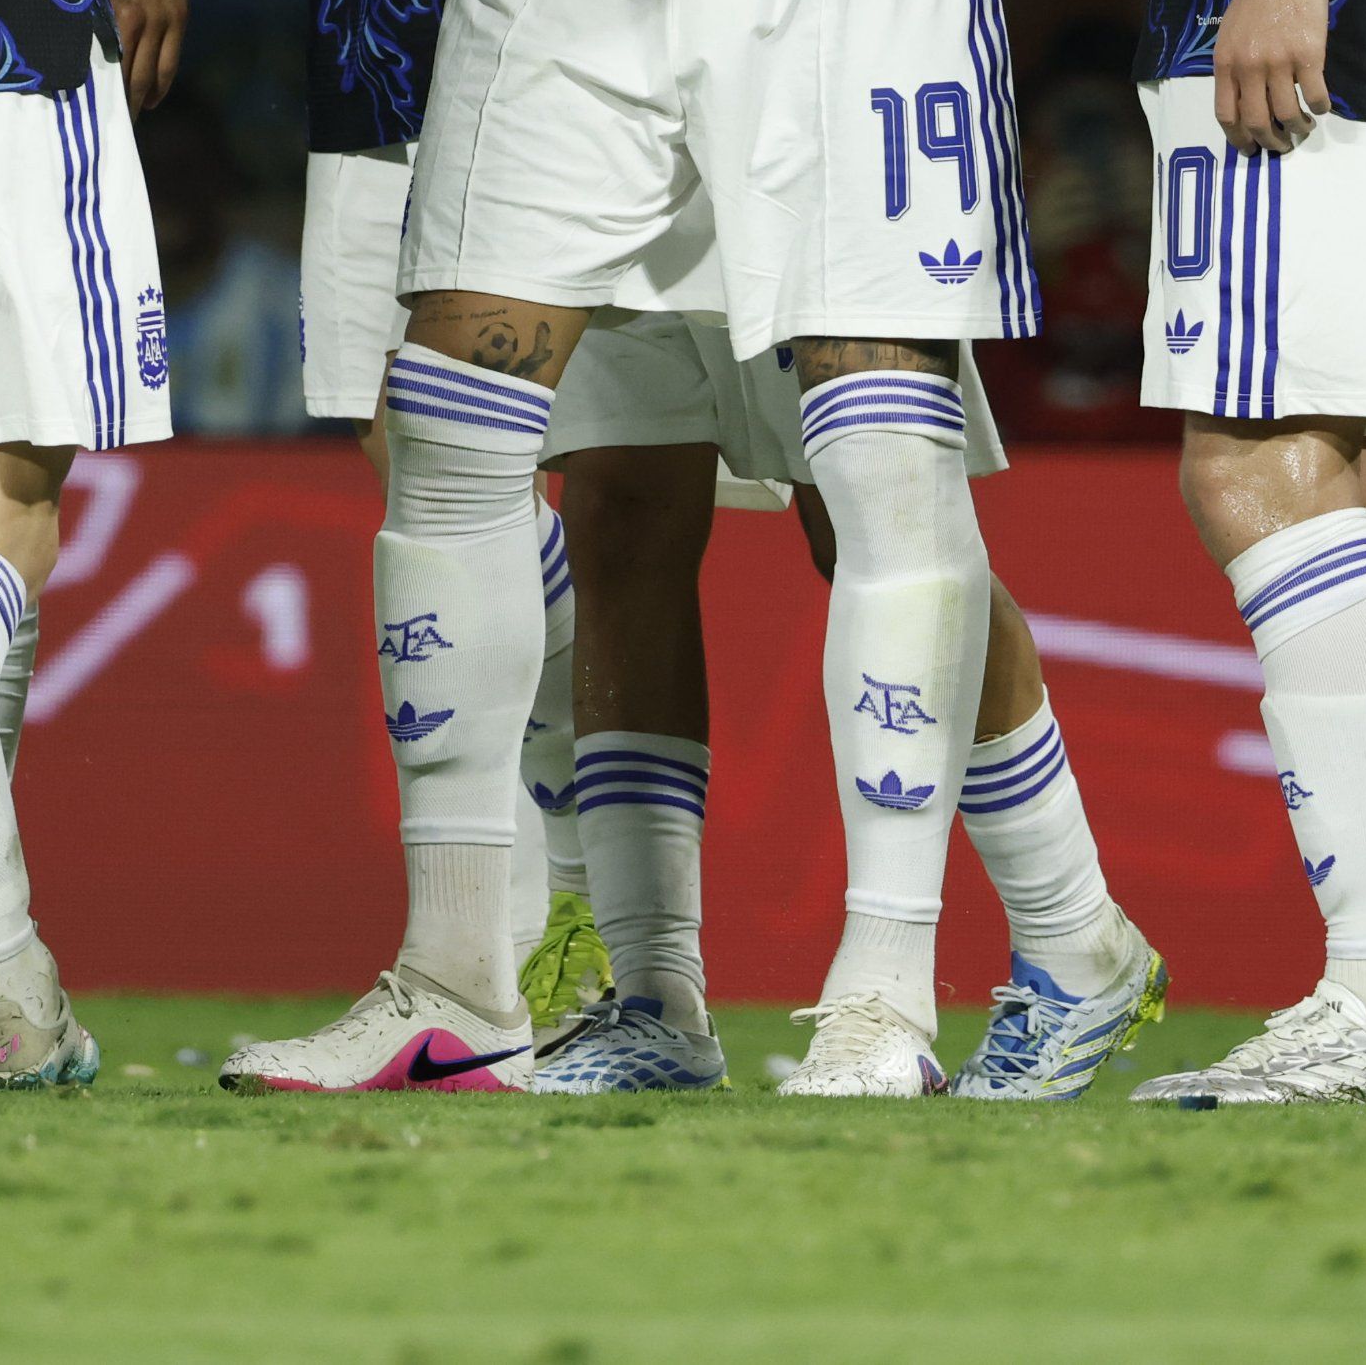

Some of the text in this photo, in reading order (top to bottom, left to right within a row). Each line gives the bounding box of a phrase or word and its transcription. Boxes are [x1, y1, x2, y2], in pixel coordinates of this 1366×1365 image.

[870, 80, 980, 221] 19
[1157, 145, 1219, 282] 0
[378, 613, 453, 663] AFA
[853, 672, 938, 735] AFA
